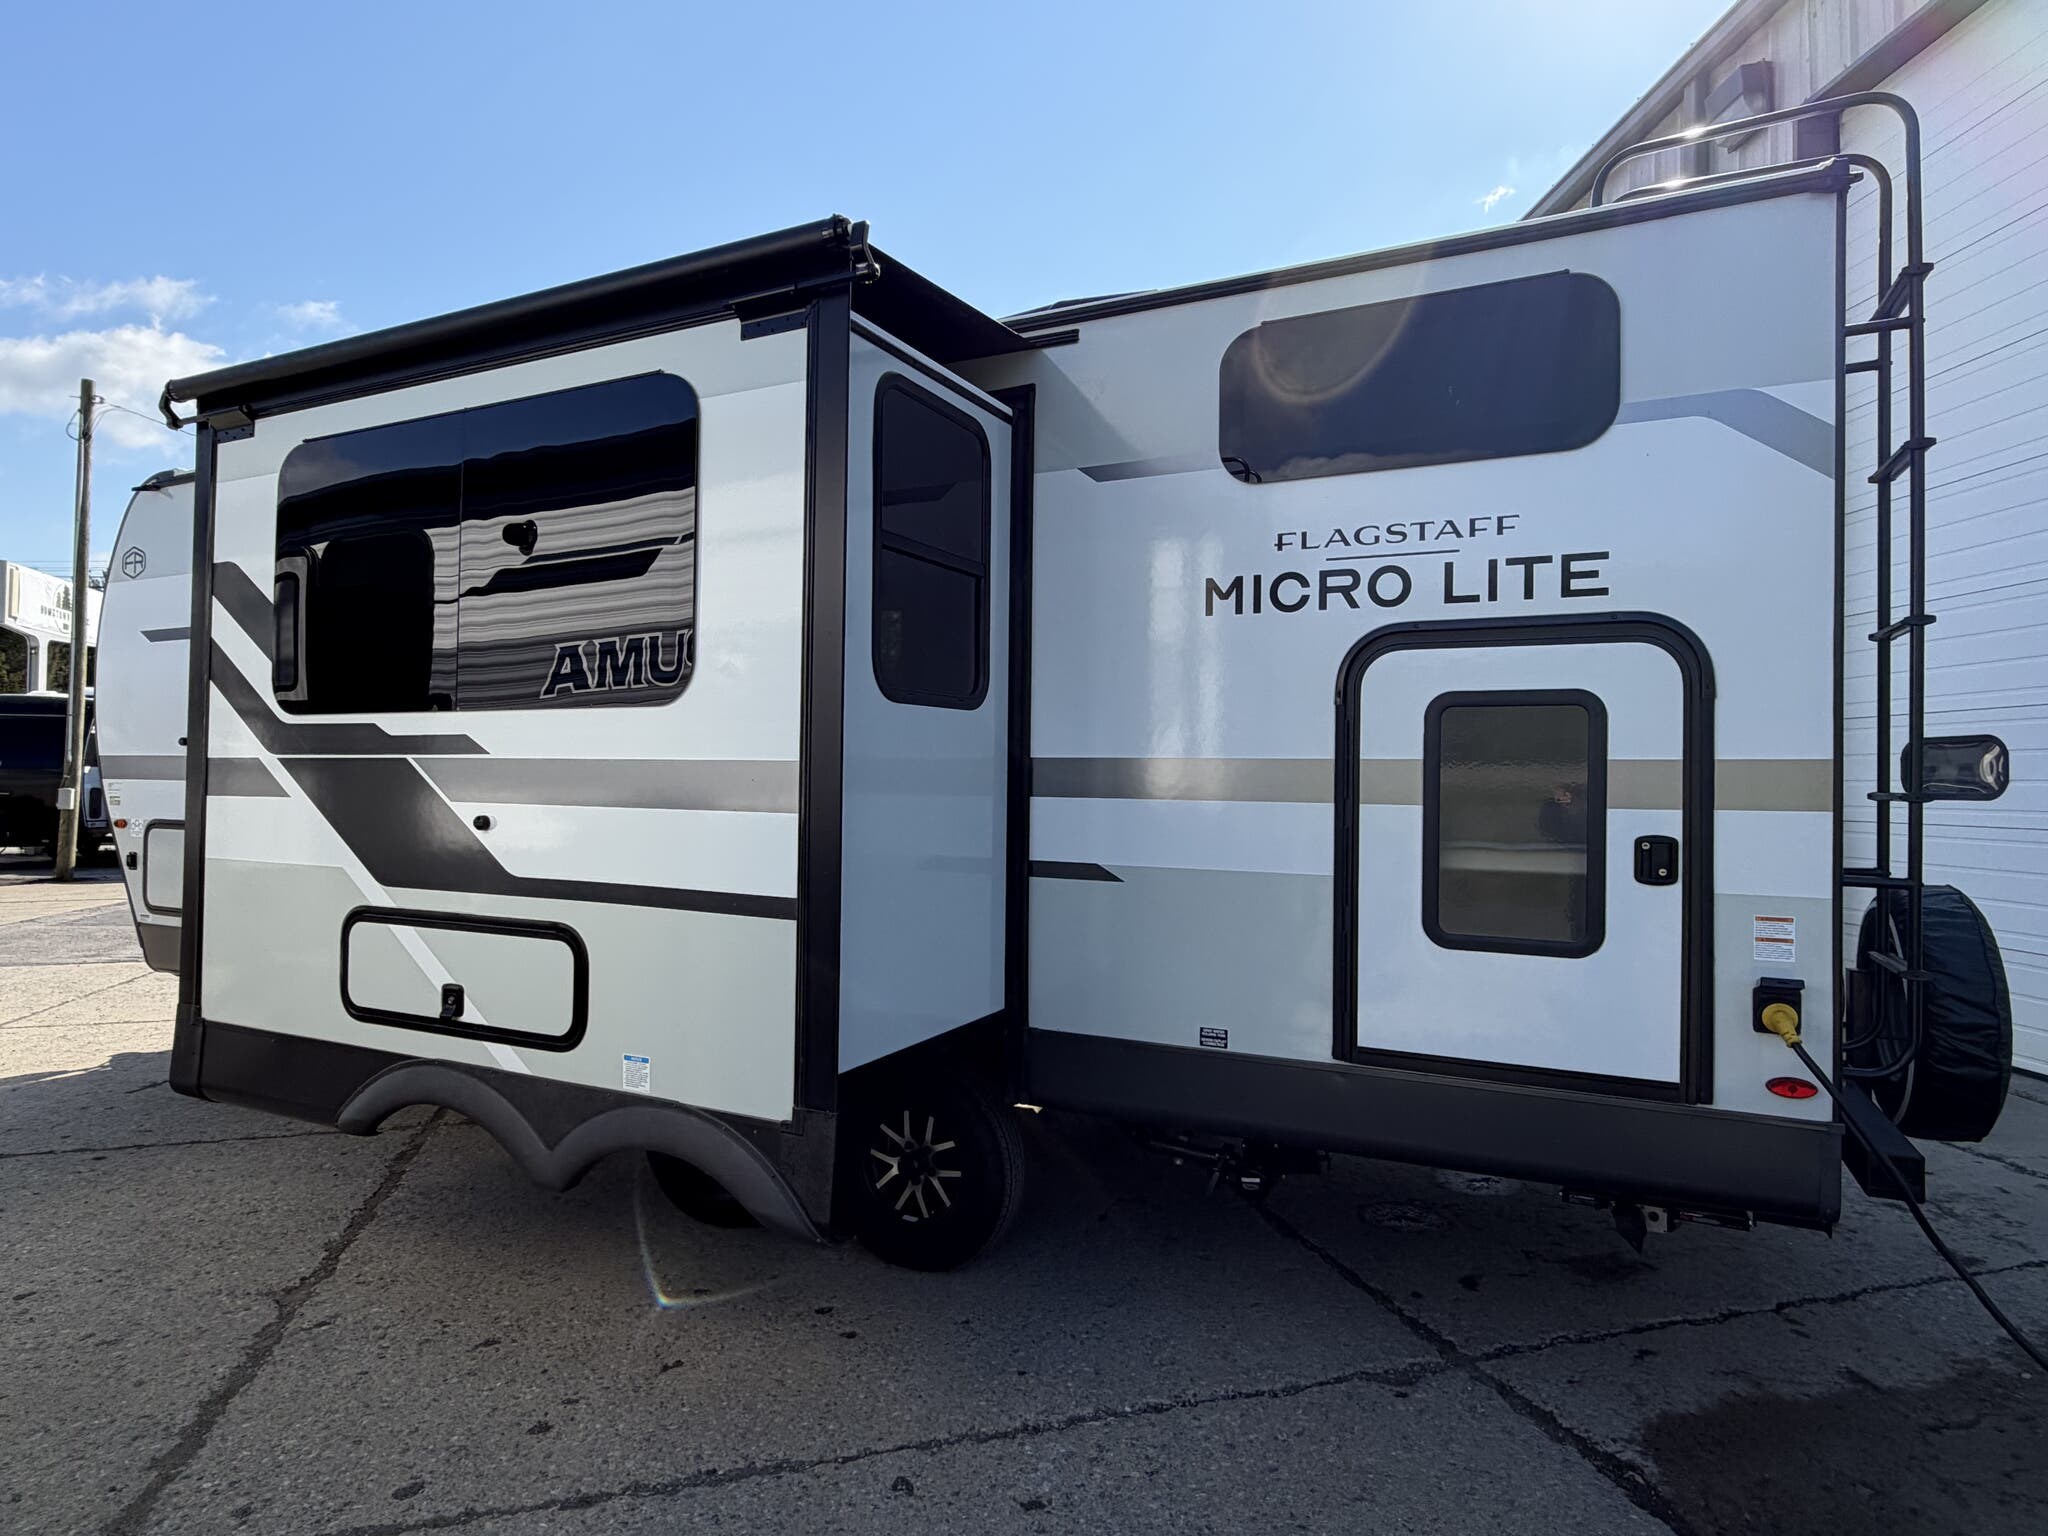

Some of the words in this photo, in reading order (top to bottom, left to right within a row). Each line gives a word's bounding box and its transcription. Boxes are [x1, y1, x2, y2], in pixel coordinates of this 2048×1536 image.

[1274, 514, 1520, 551] FLAGSTAFF
[1205, 564, 1412, 617] MICRO
[1443, 551, 1610, 604] LITE
